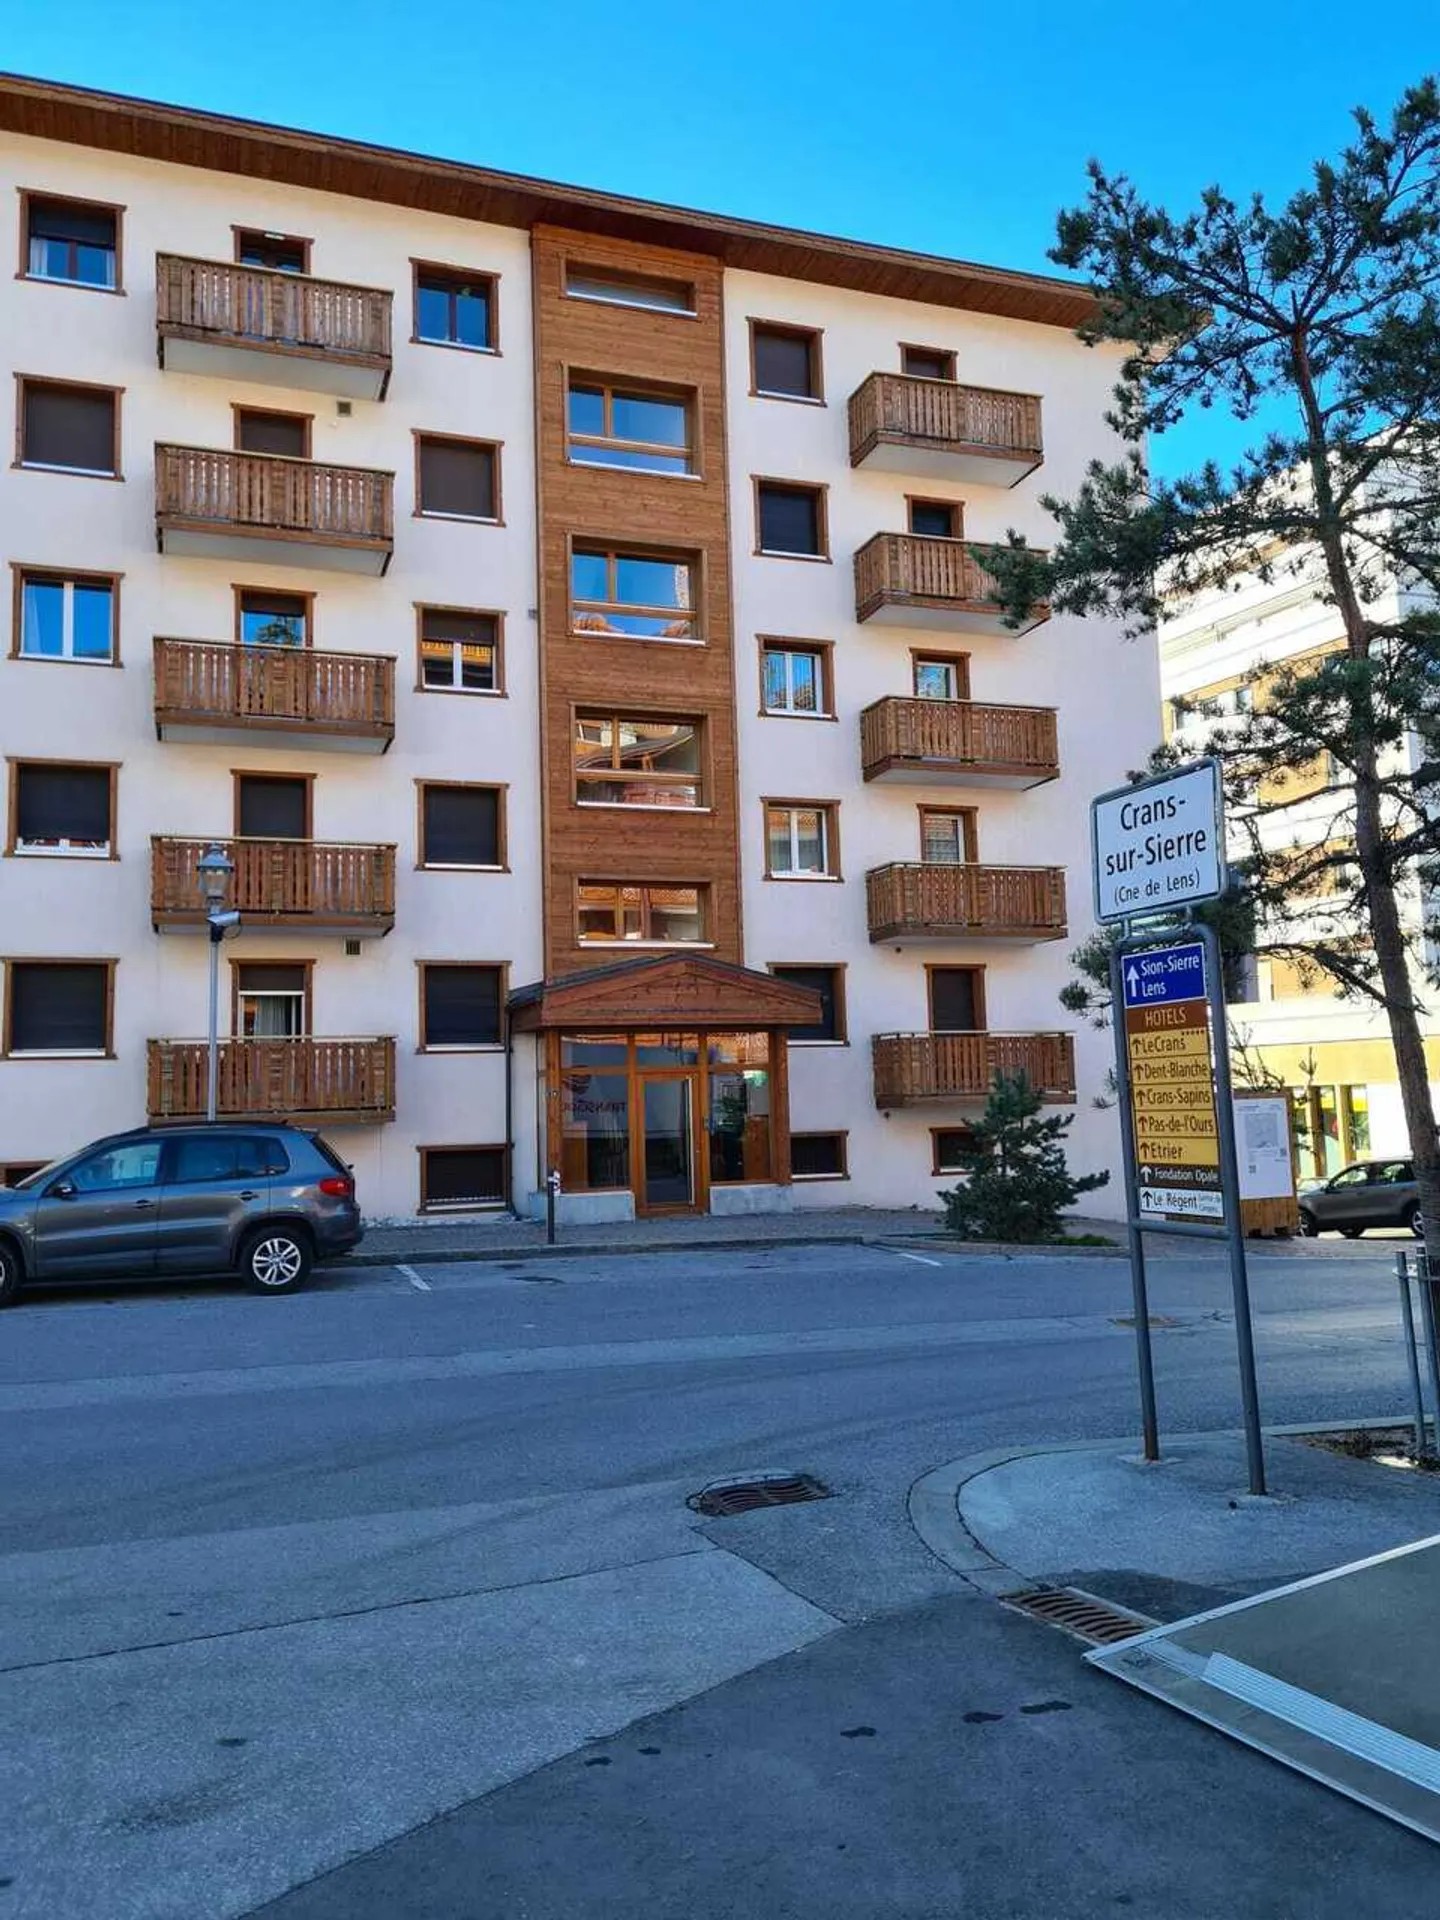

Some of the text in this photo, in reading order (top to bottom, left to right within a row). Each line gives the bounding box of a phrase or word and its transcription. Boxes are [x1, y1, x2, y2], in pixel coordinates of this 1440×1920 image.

[1120, 795, 1187, 831] Crans-
[1105, 829, 1206, 876] sur-Sierre
[1114, 868, 1200, 906] (Cne de Lens)
[1140, 954, 1200, 976] Sion-Sierre
[1141, 980, 1167, 997] Lens
[1145, 1006, 1187, 1027] HOTELS
[1144, 1059, 1208, 1079] Dent-Blanche
[1147, 1086, 1211, 1108] Crans-Sapins
[1151, 1142, 1183, 1159] Etrier
